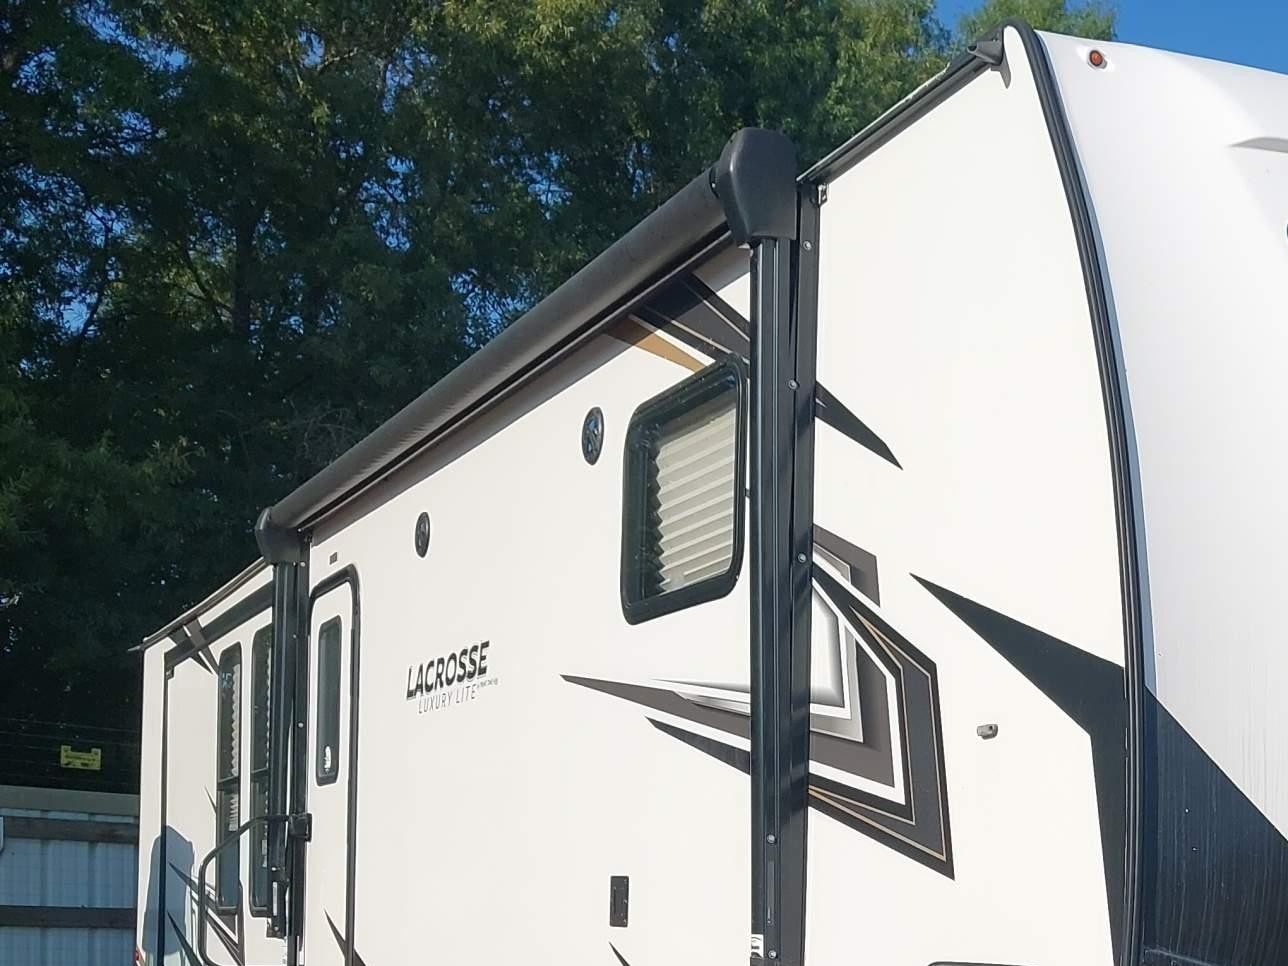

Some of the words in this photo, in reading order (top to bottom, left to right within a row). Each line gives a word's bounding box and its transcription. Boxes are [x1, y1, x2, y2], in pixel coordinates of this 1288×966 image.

[407, 640, 490, 699] LACROSSE
[418, 690, 453, 714] LUXURY
[456, 683, 477, 703] LITE
